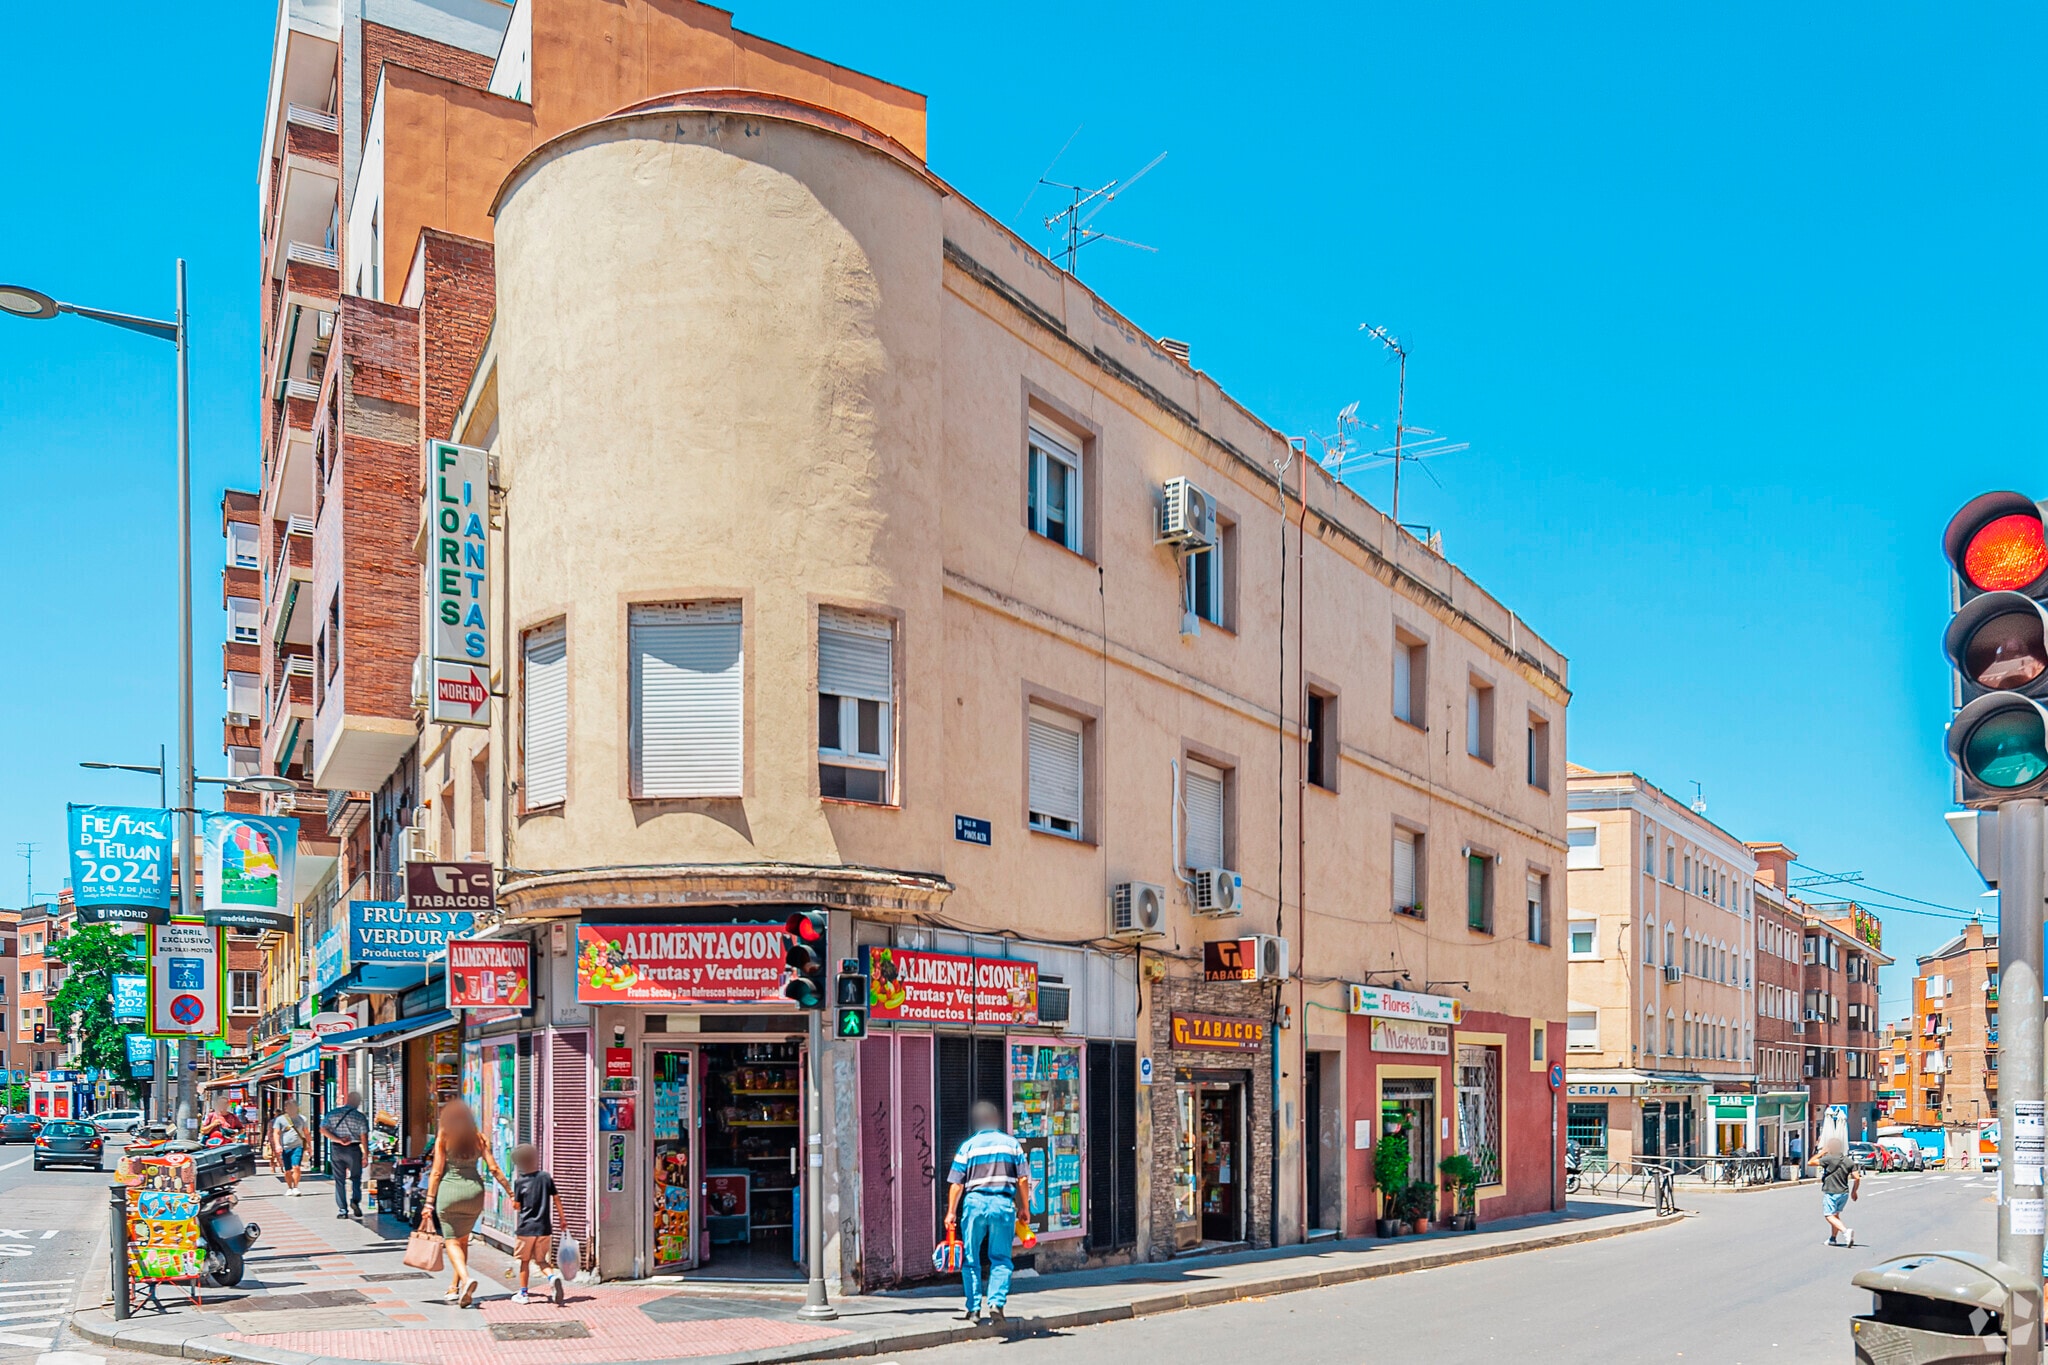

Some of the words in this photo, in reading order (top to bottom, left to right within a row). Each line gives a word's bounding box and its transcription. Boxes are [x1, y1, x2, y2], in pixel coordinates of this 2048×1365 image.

[438, 446, 461, 625] FLORES
[440, 682, 483, 702] MORENO
[82, 815, 163, 839] FIESTAS
[93, 839, 160, 861] TETUAN
[81, 861, 160, 884] 2024
[139, 886, 160, 895] JULIO
[413, 895, 489, 908] TABACOS
[109, 909, 148, 919] MADRID
[362, 948, 420, 957] Productos
[623, 932, 782, 959] ALIMENTACION
[451, 947, 525, 967] ALIMENTACION
[639, 964, 690, 981] Frutas
[692, 968, 703, 984] y
[705, 964, 778, 981] Verduras
[898, 957, 1013, 988] ALIMENTACION
[1205, 969, 1256, 980] TABACOS
[119, 998, 146, 1008] 202
[628, 987, 649, 997] Frutos
[650, 987, 672, 997] Secos
[671, 989, 677, 999] y
[678, 987, 690, 997] Pan
[692, 987, 726, 997] Refrescos
[727, 987, 754, 997] Helados
[755, 989, 761, 999] y
[905, 986, 945, 1002] Frutas
[946, 992, 954, 1005] y
[955, 989, 1008, 1005] Verduras
[900, 1005, 964, 1020] Productos
[967, 1008, 1012, 1022] Latinos
[1381, 993, 1410, 1014] Flores
[1193, 1020, 1263, 1040] TABACOS
[1720, 1096, 1742, 1105] BAR
